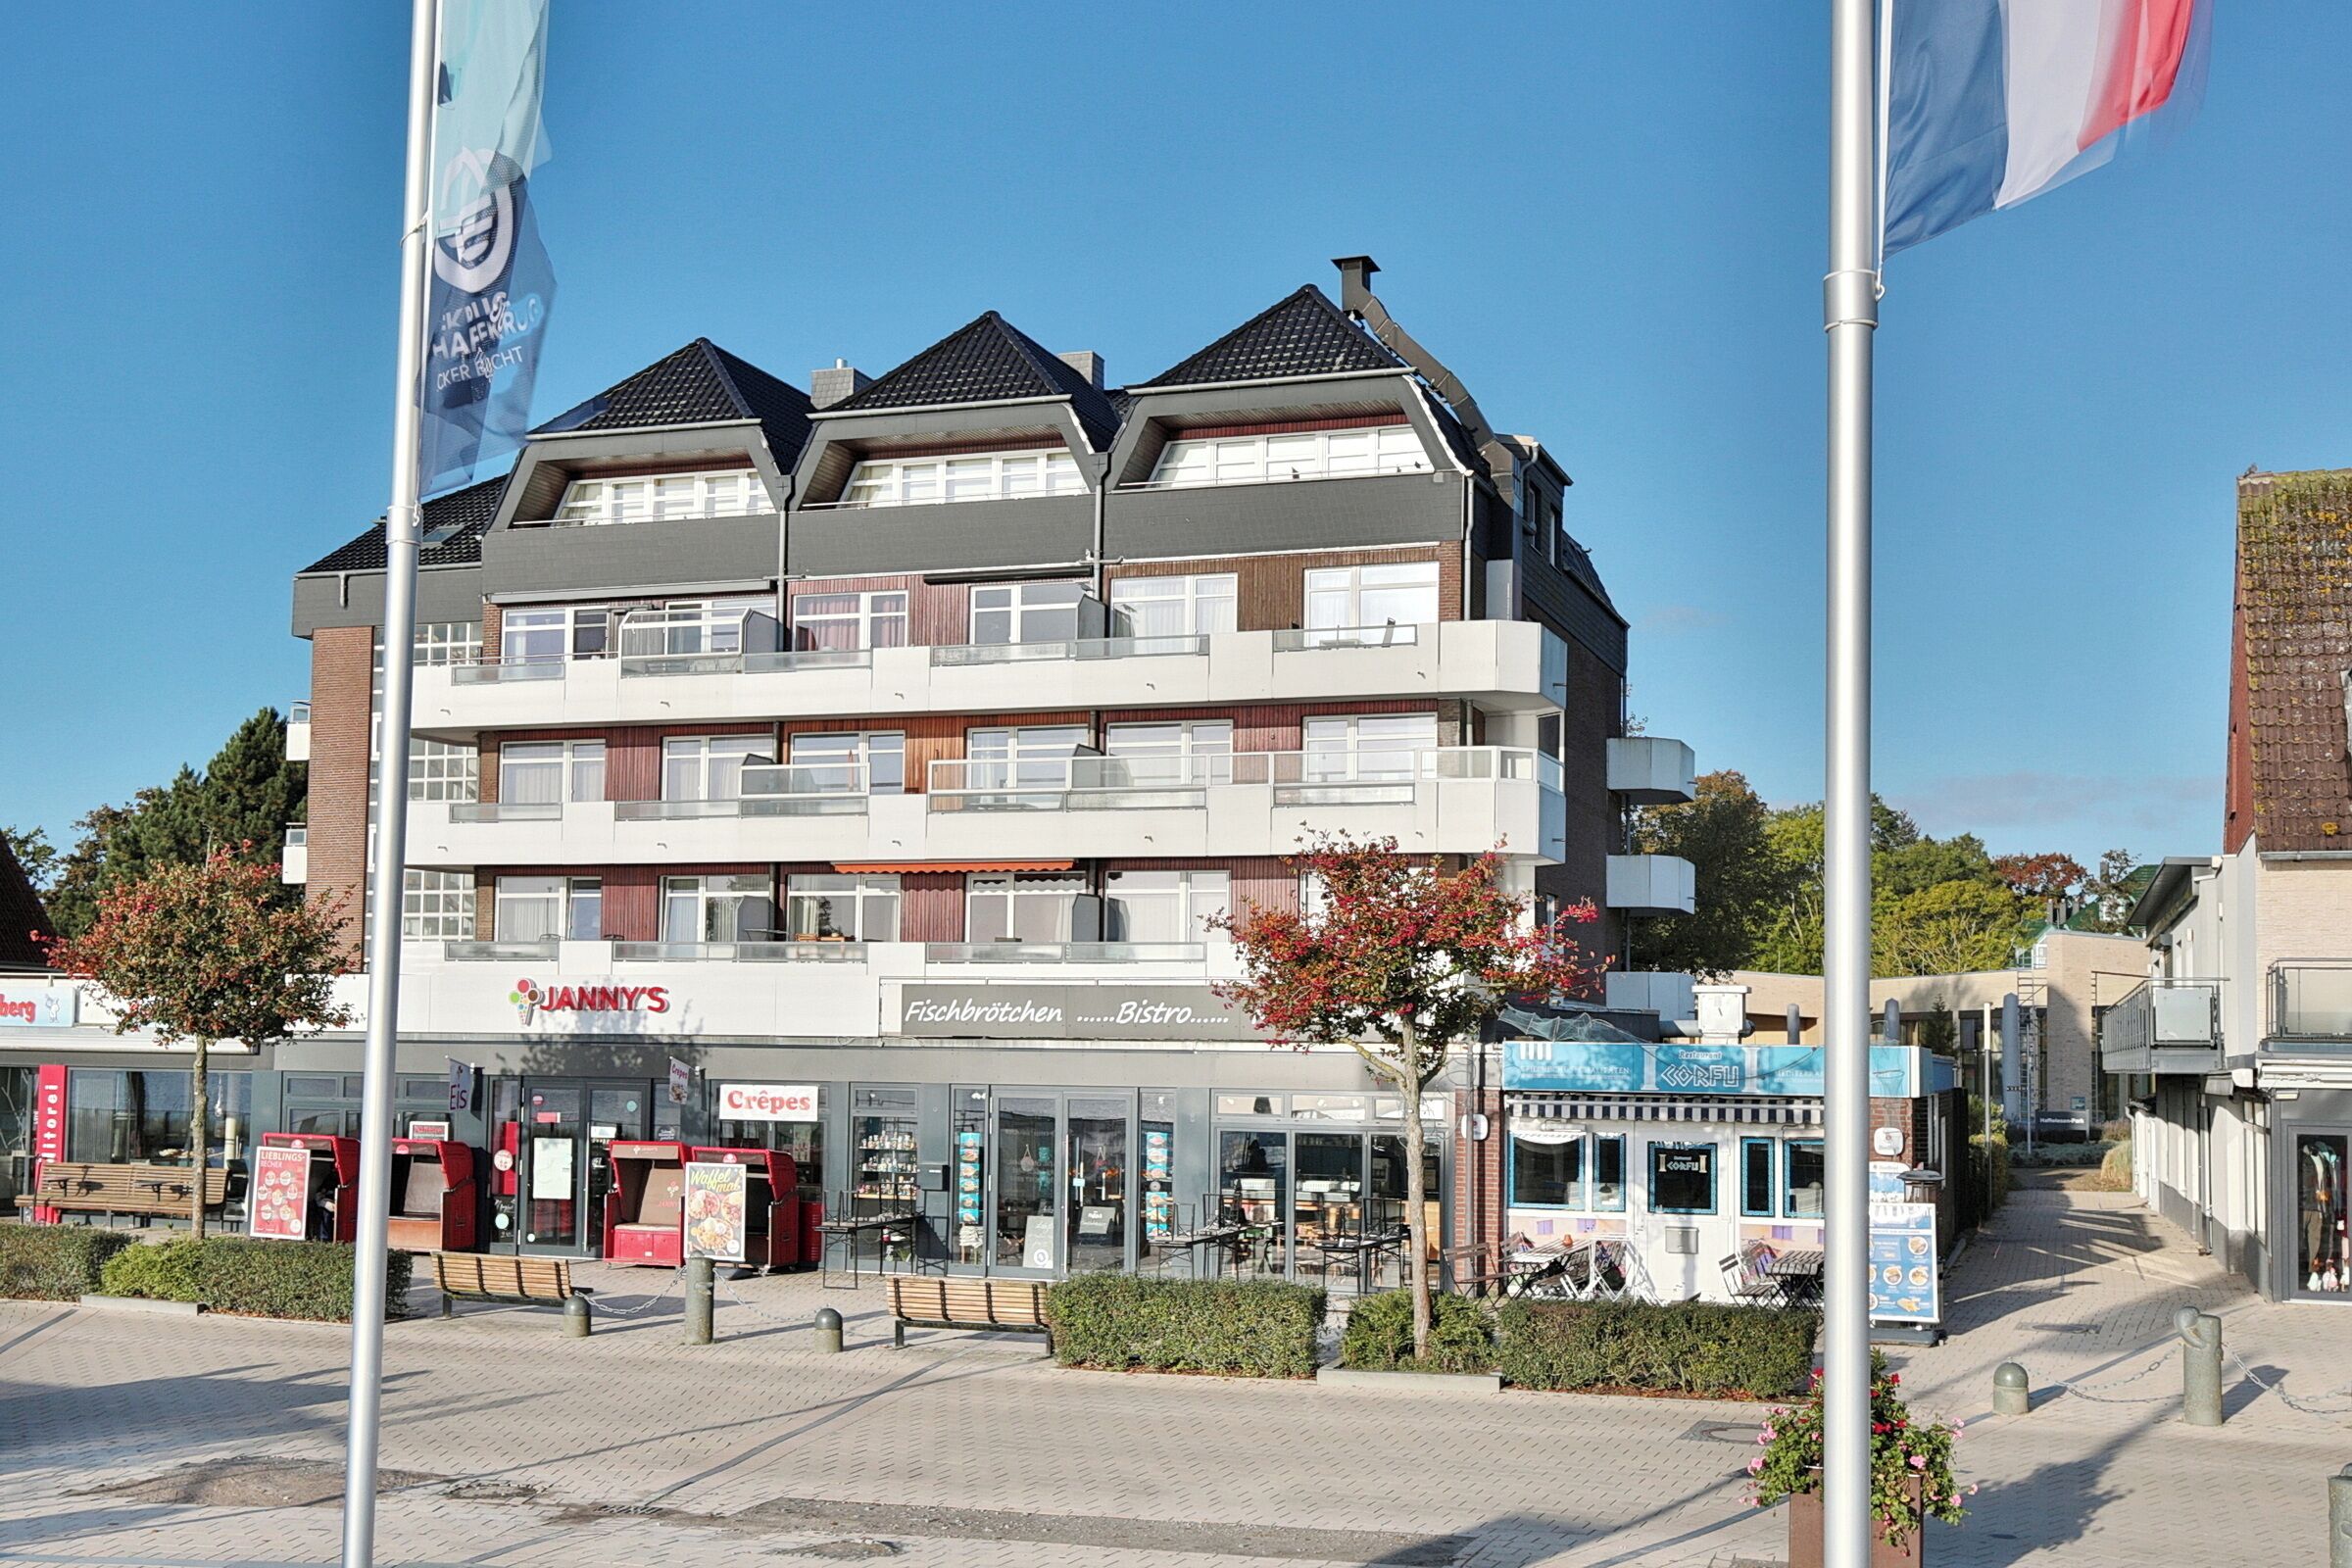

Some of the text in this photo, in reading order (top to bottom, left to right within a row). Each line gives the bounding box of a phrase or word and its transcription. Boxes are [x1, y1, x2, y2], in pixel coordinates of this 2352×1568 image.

[539, 985, 668, 1012] JANNY'S
[905, 998, 1062, 1022] Fischbrötchen
[1678, 1050, 1722, 1059] Restaurant
[1661, 1063, 1740, 1088] CORFU
[449, 1084, 467, 1110] Eis
[727, 1090, 810, 1114] Crêpes
[261, 1151, 305, 1161] LIEBLINGS-
[1666, 1161, 1699, 1171] CORFU
[691, 1168, 731, 1190] Waffel
